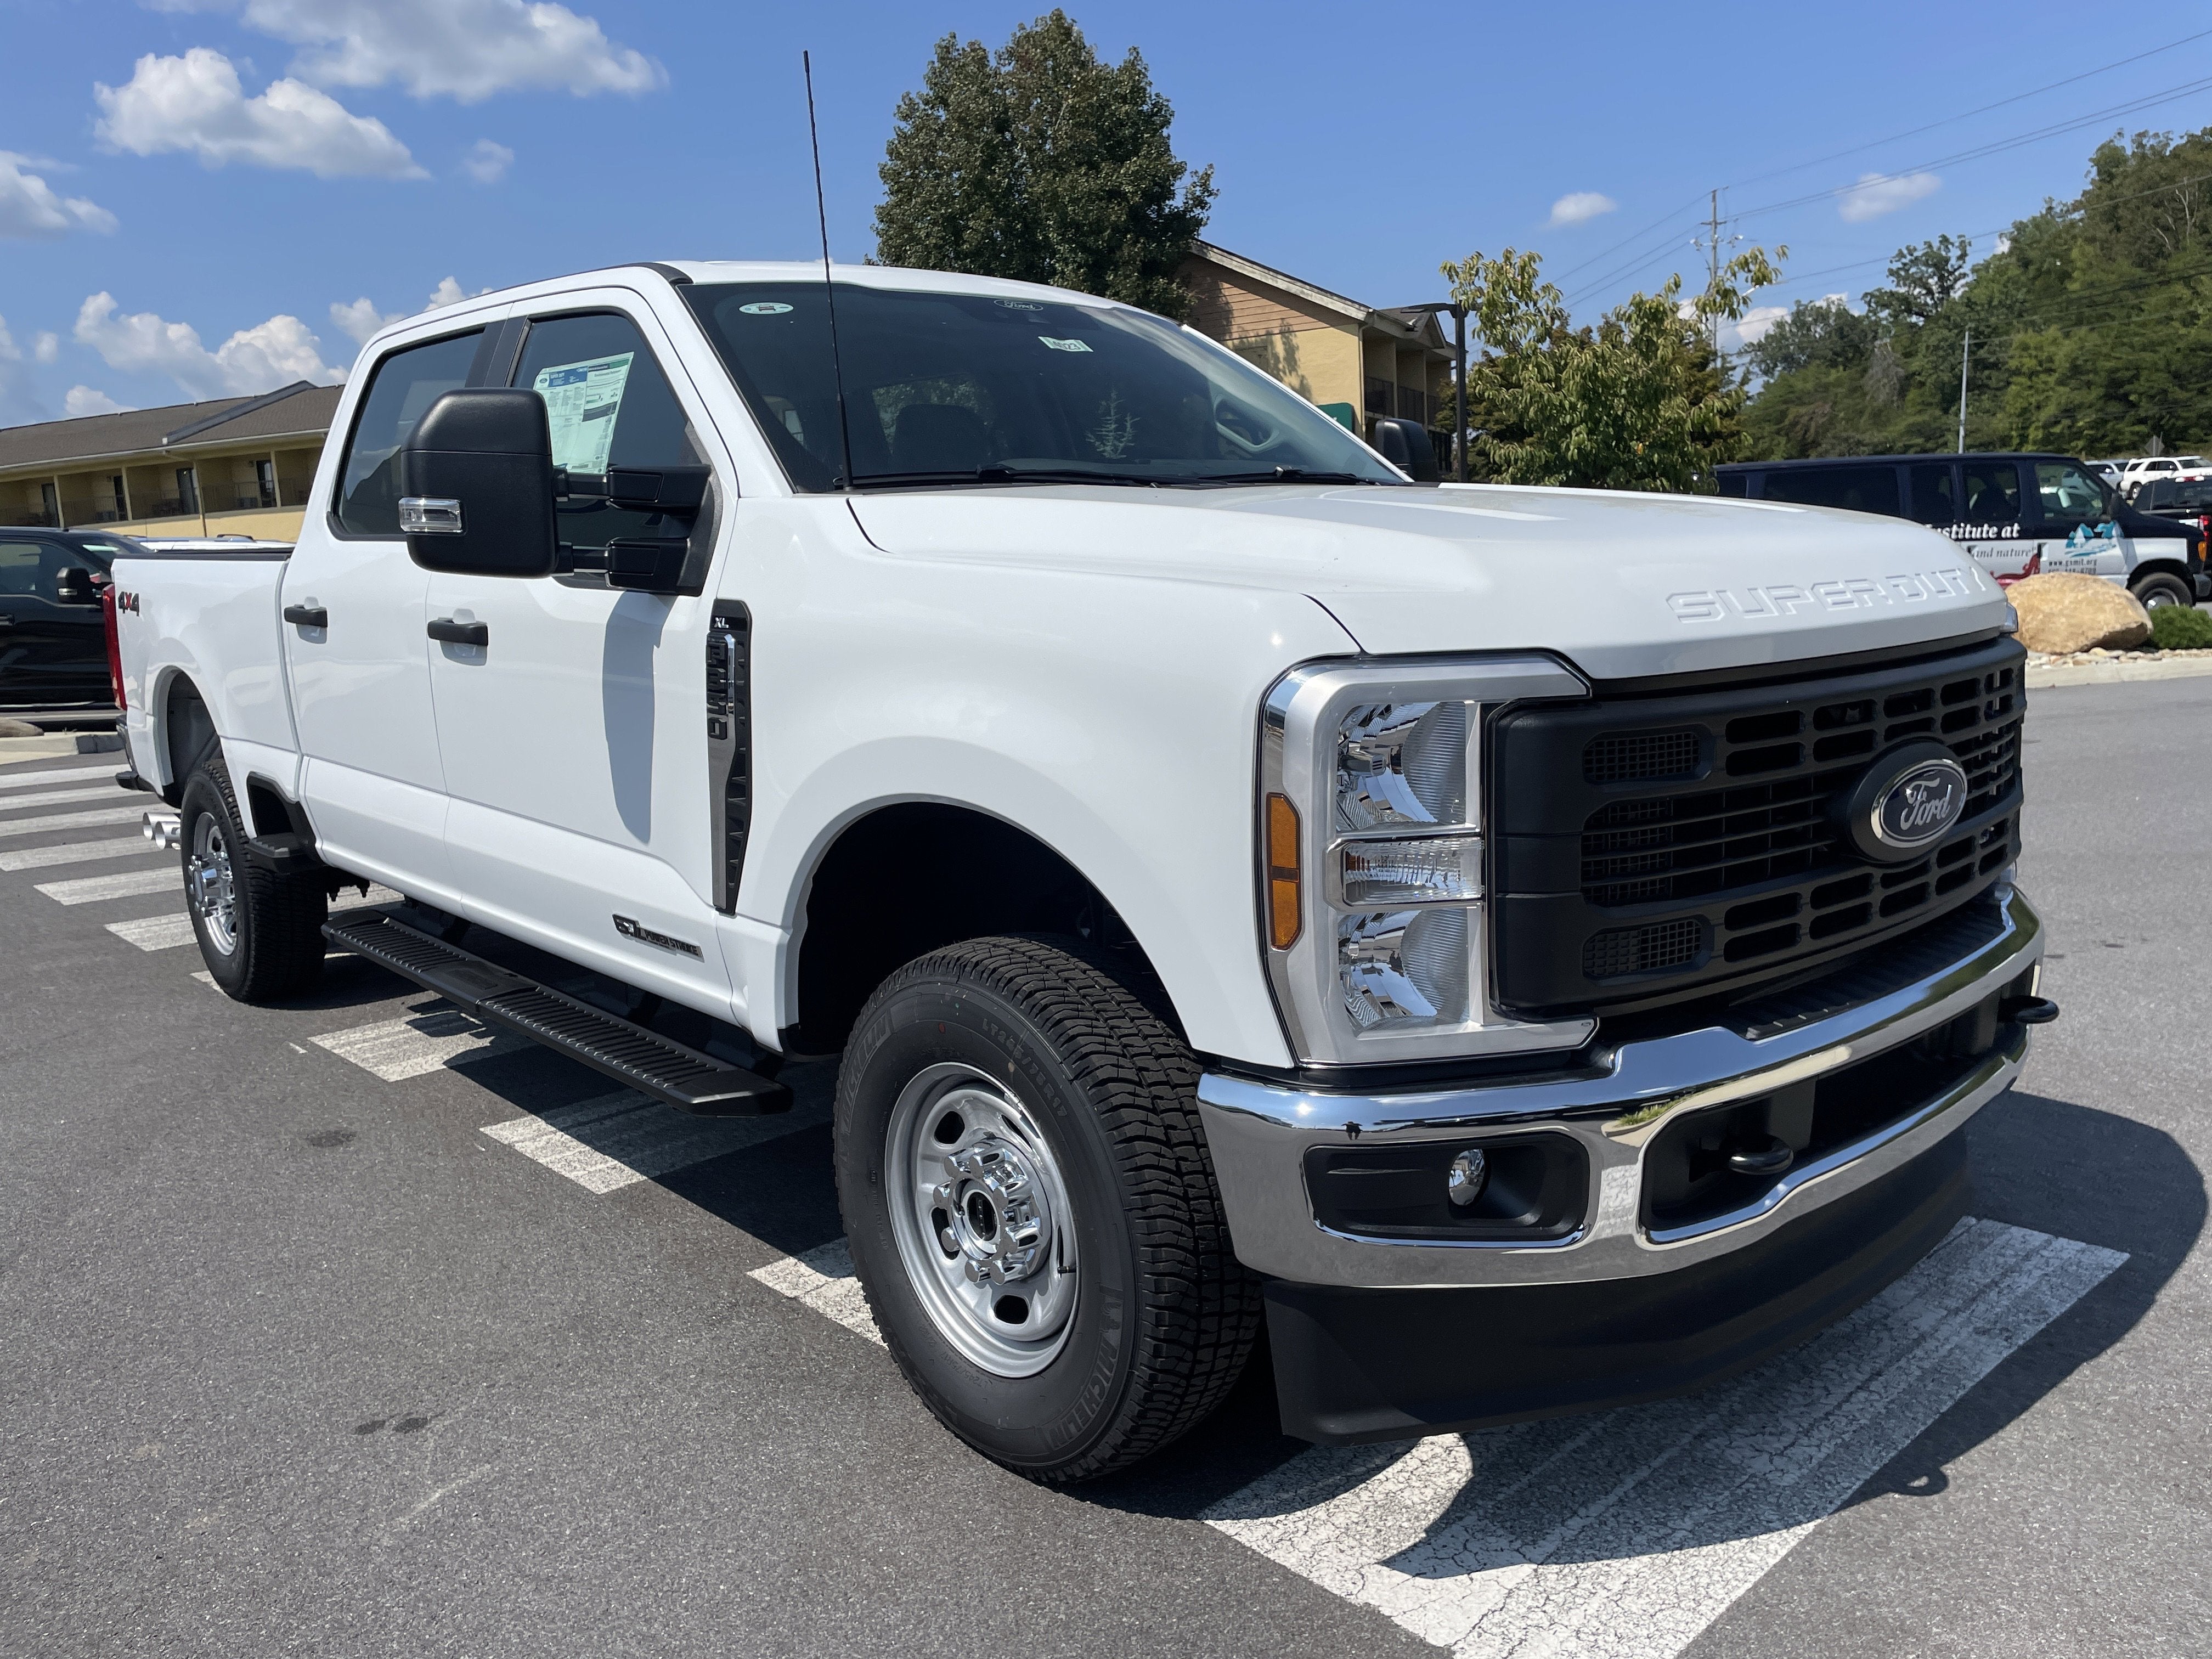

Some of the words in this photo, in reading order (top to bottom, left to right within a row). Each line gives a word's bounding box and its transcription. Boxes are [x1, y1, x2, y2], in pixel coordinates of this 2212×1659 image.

[1926, 523, 1998, 539] stitute
[2001, 523, 2021, 539] at
[1666, 578, 1894, 624] SUPER
[1885, 566, 1987, 603] DUTY
[714, 617, 729, 629] XL
[1900, 777, 1952, 831] Ford
[1047, 1334, 1118, 1449] MICHELIN
